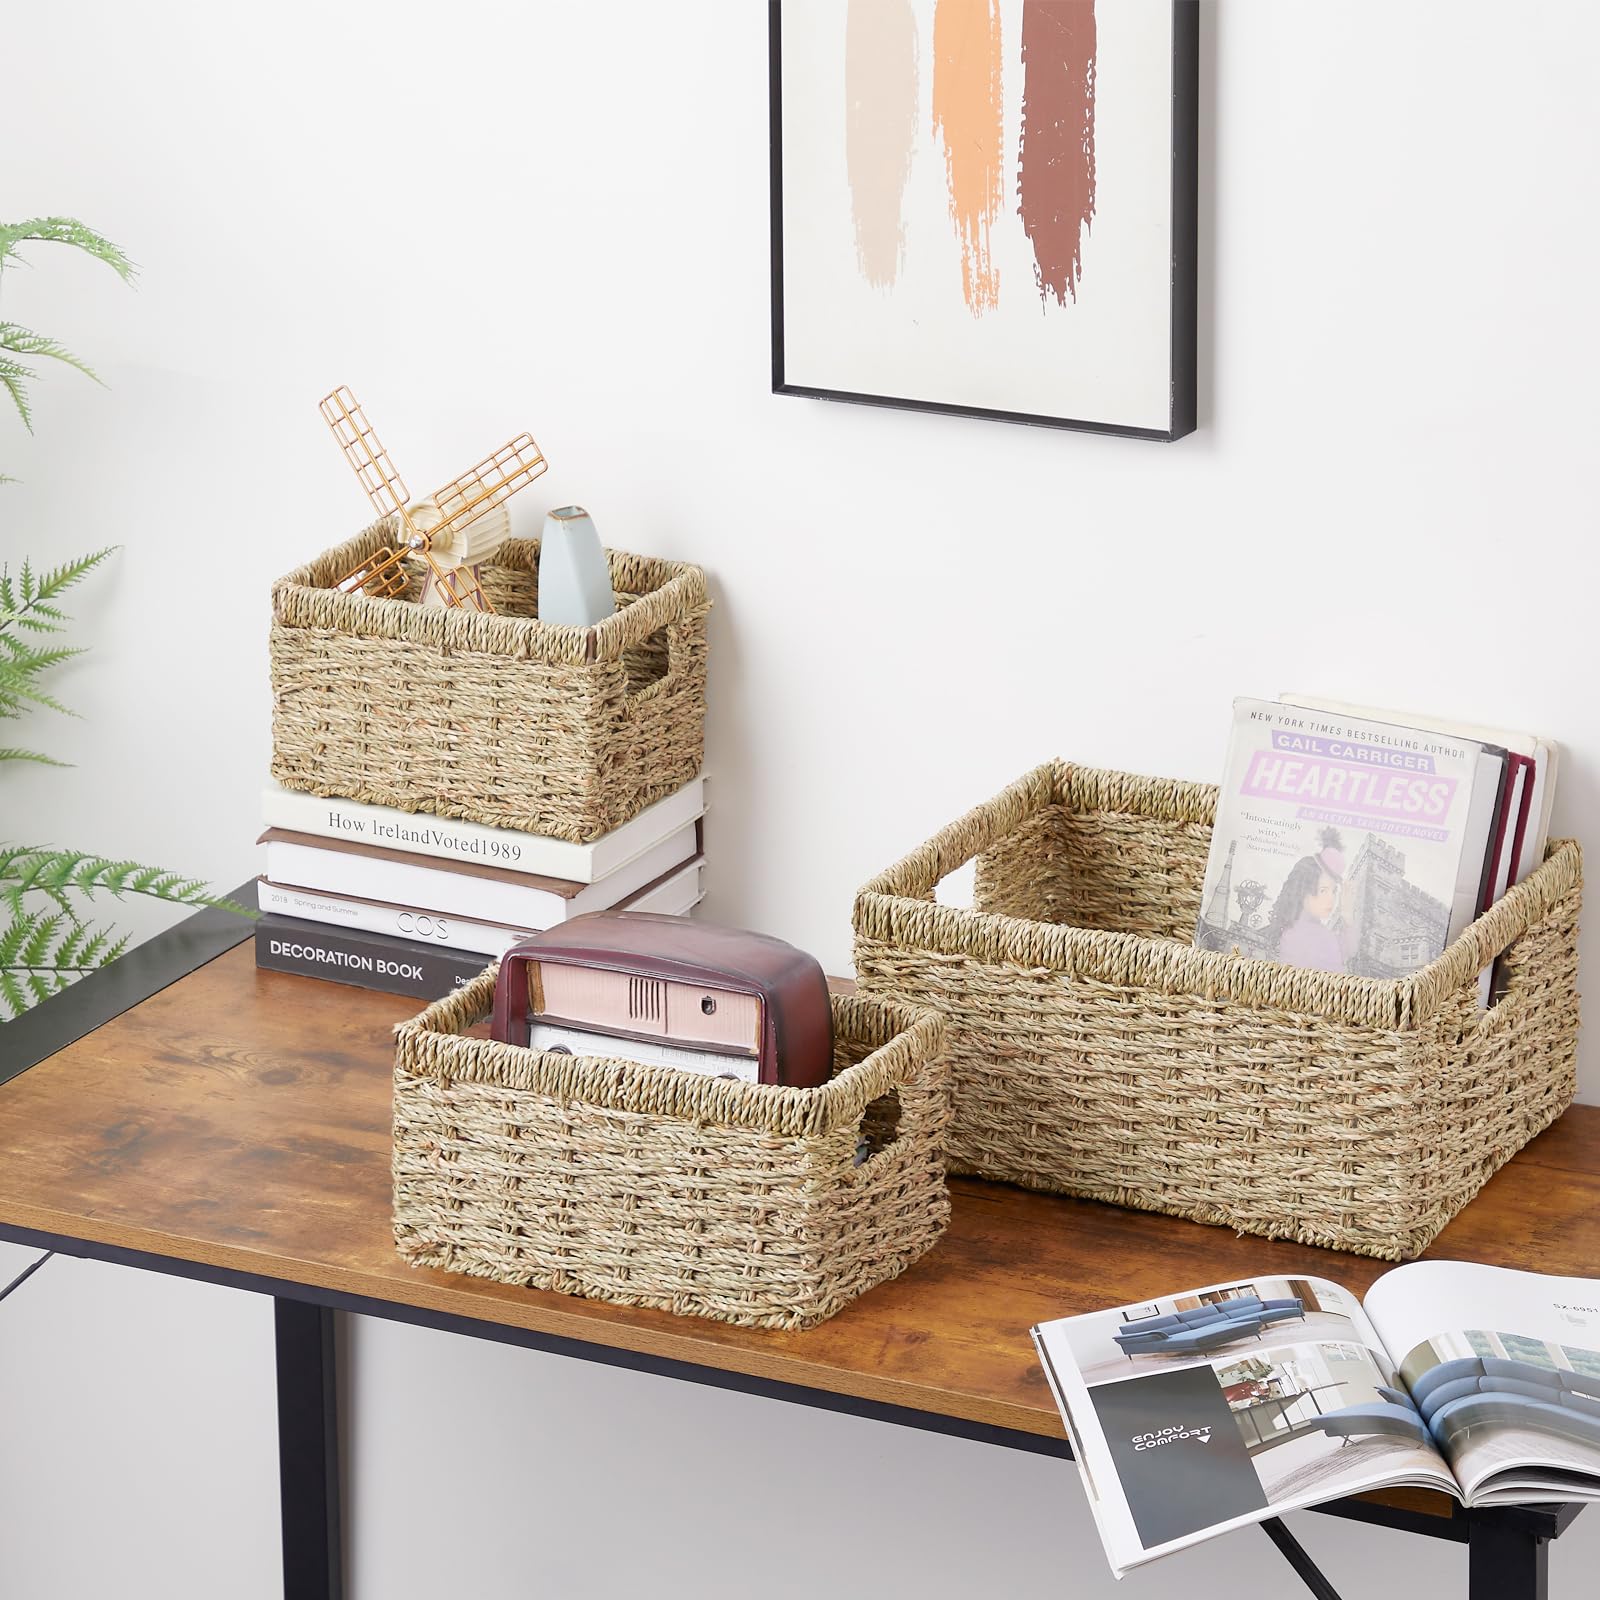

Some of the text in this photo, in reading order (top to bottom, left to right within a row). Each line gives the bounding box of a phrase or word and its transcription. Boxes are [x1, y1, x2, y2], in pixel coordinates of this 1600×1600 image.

[1250, 711, 1466, 760] NEW YORK TIMES BESTSELLING AUTHOR
[1277, 735, 1430, 771] GAIL CARRIGER
[1251, 757, 1450, 816] HEARTLESS
[328, 812, 522, 861] How IrelandVoted1989
[294, 898, 317, 910] Spring
[317, 903, 332, 912] and
[397, 912, 449, 940] COS
[270, 940, 373, 971] DECORATION
[376, 960, 423, 981] BOOK
[1132, 1425, 1184, 1443] ENJOY
[1134, 1426, 1212, 1451] COMFORT
